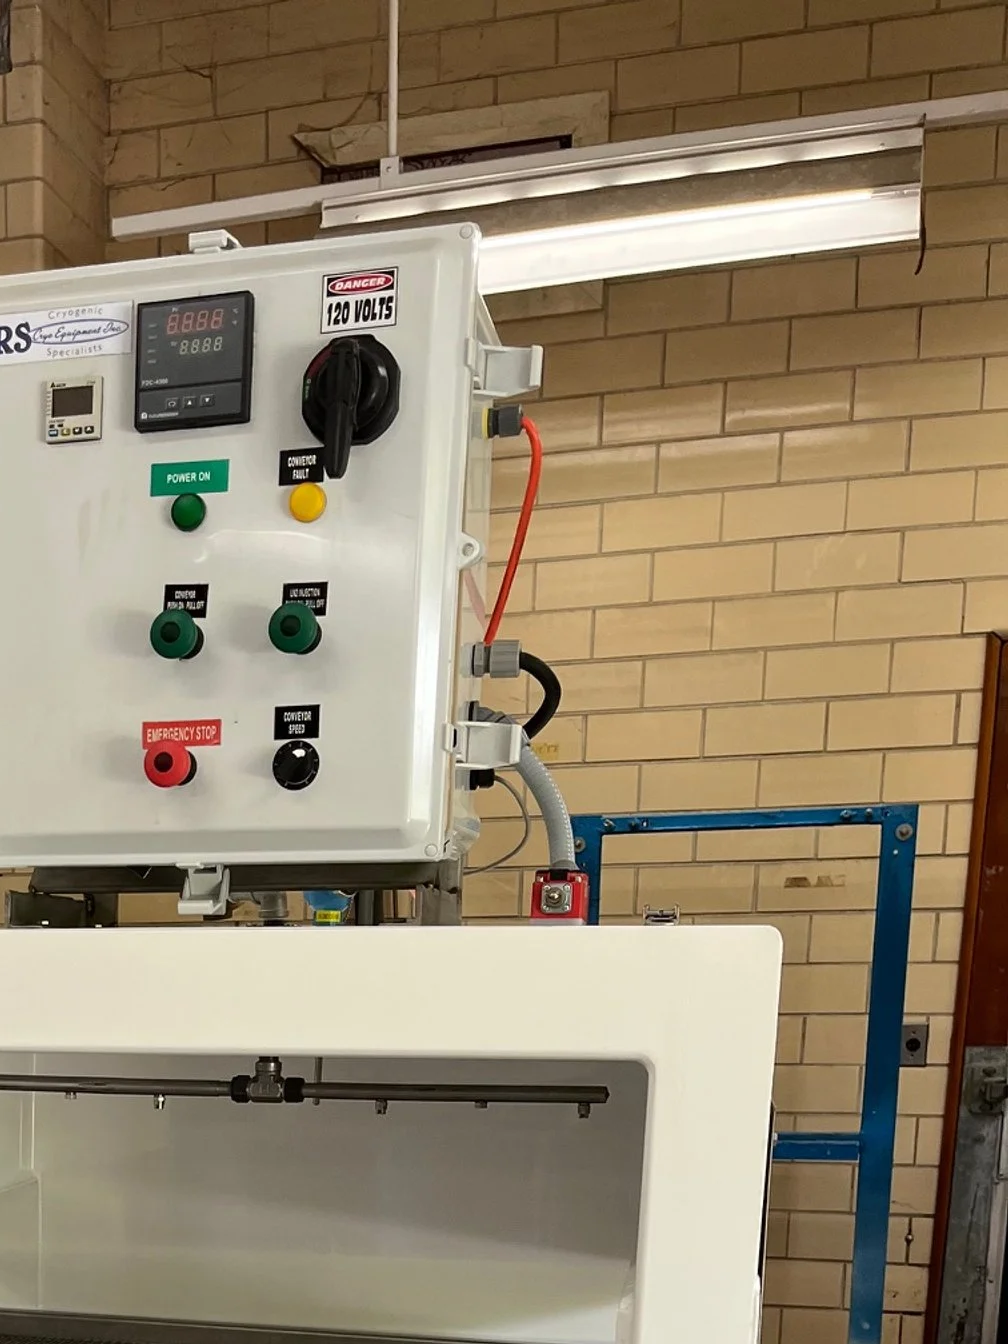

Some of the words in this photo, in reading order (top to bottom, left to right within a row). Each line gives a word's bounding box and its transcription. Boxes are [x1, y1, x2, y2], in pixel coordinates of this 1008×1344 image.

[334, 277, 386, 291] DANGER
[48, 306, 103, 320] Cryogenic
[327, 301, 350, 326] 120
[354, 296, 394, 322] VOLTS
[54, 326, 101, 342] Equipment
[46, 344, 103, 358] Specialists
[288, 454, 317, 467] CONVEYOR
[166, 472, 197, 484] POWER
[198, 471, 211, 481] ON
[283, 710, 312, 722] CONVEYOR
[146, 726, 195, 743] EMERGENCY
[195, 725, 217, 741] STOP
[288, 723, 306, 735] SPEED
